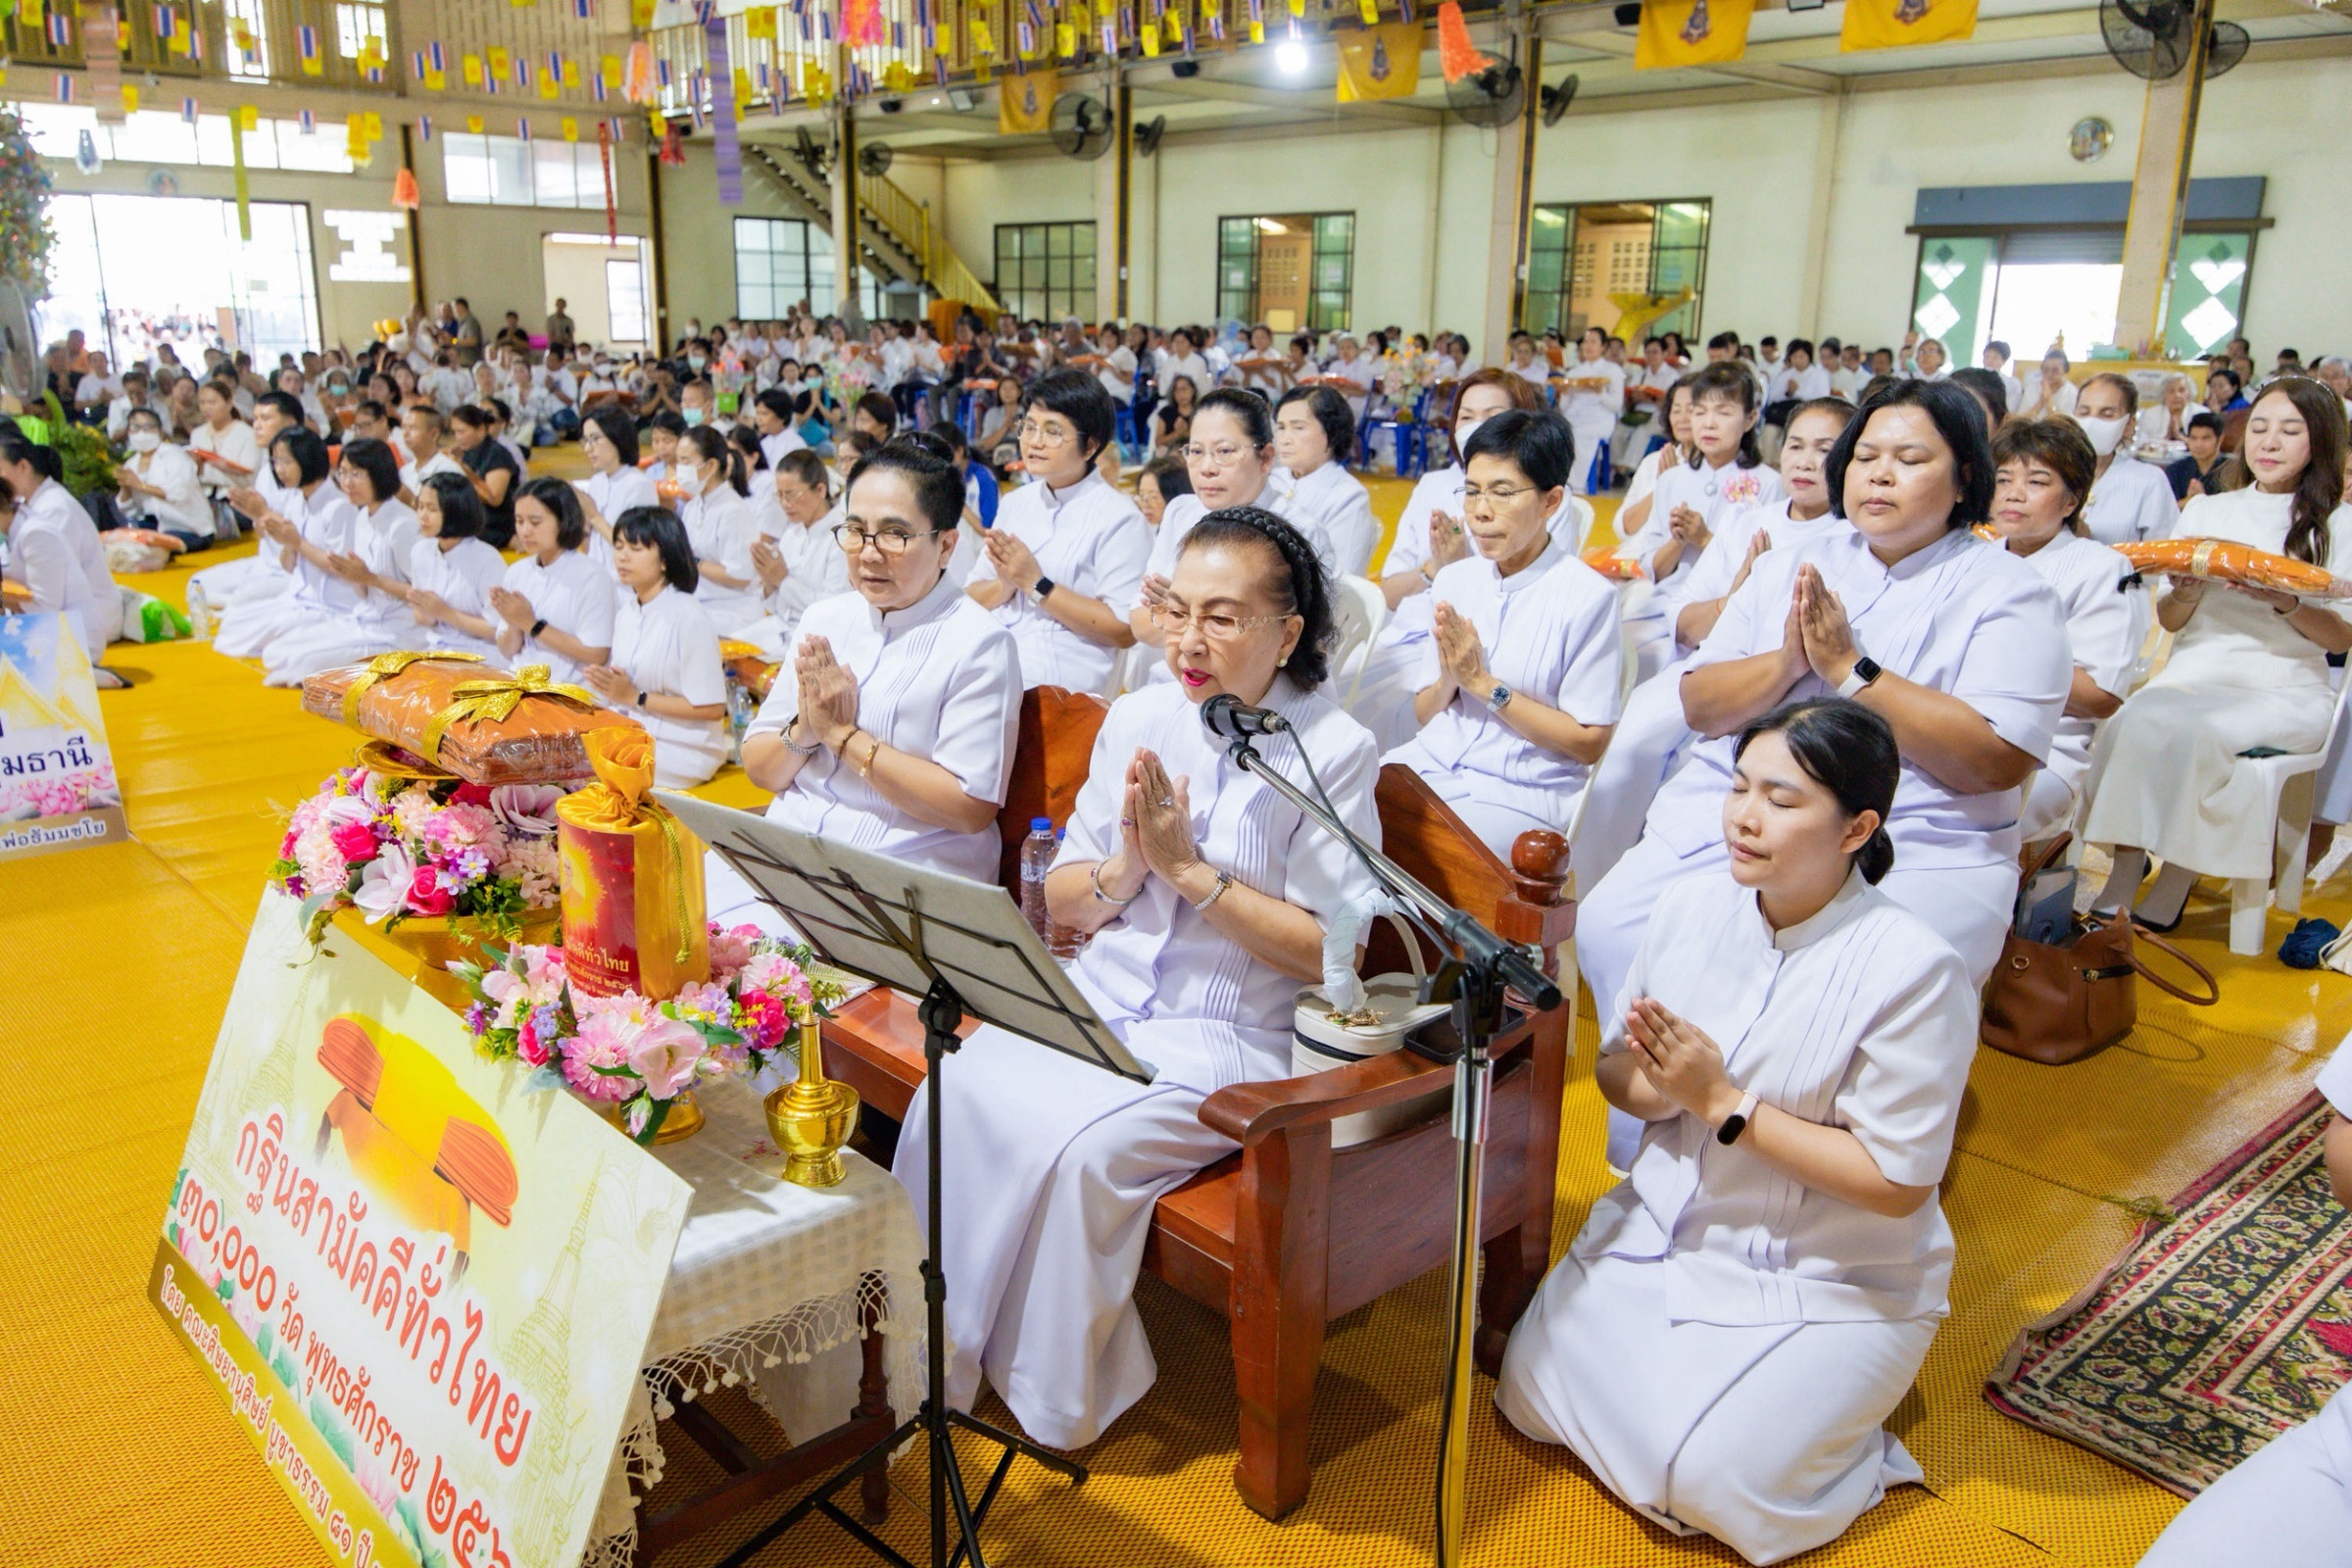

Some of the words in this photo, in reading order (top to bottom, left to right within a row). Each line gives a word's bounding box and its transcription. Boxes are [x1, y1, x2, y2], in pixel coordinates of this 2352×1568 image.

[1, 735, 93, 775] มธานี
[162, 1268, 183, 1314] โดย
[184, 1307, 272, 1430] คณะศิษยานุศิษย์
[268, 1422, 330, 1519] บูชาธรรม
[330, 1513, 352, 1552] ๘๑
[180, 1179, 276, 1311] ๓๐,๐๐๐
[279, 1281, 304, 1351] วัด
[306, 1331, 420, 1493] พุทธศักราช
[236, 1113, 531, 1467] กฐินสามัคคีทั่วไทย
